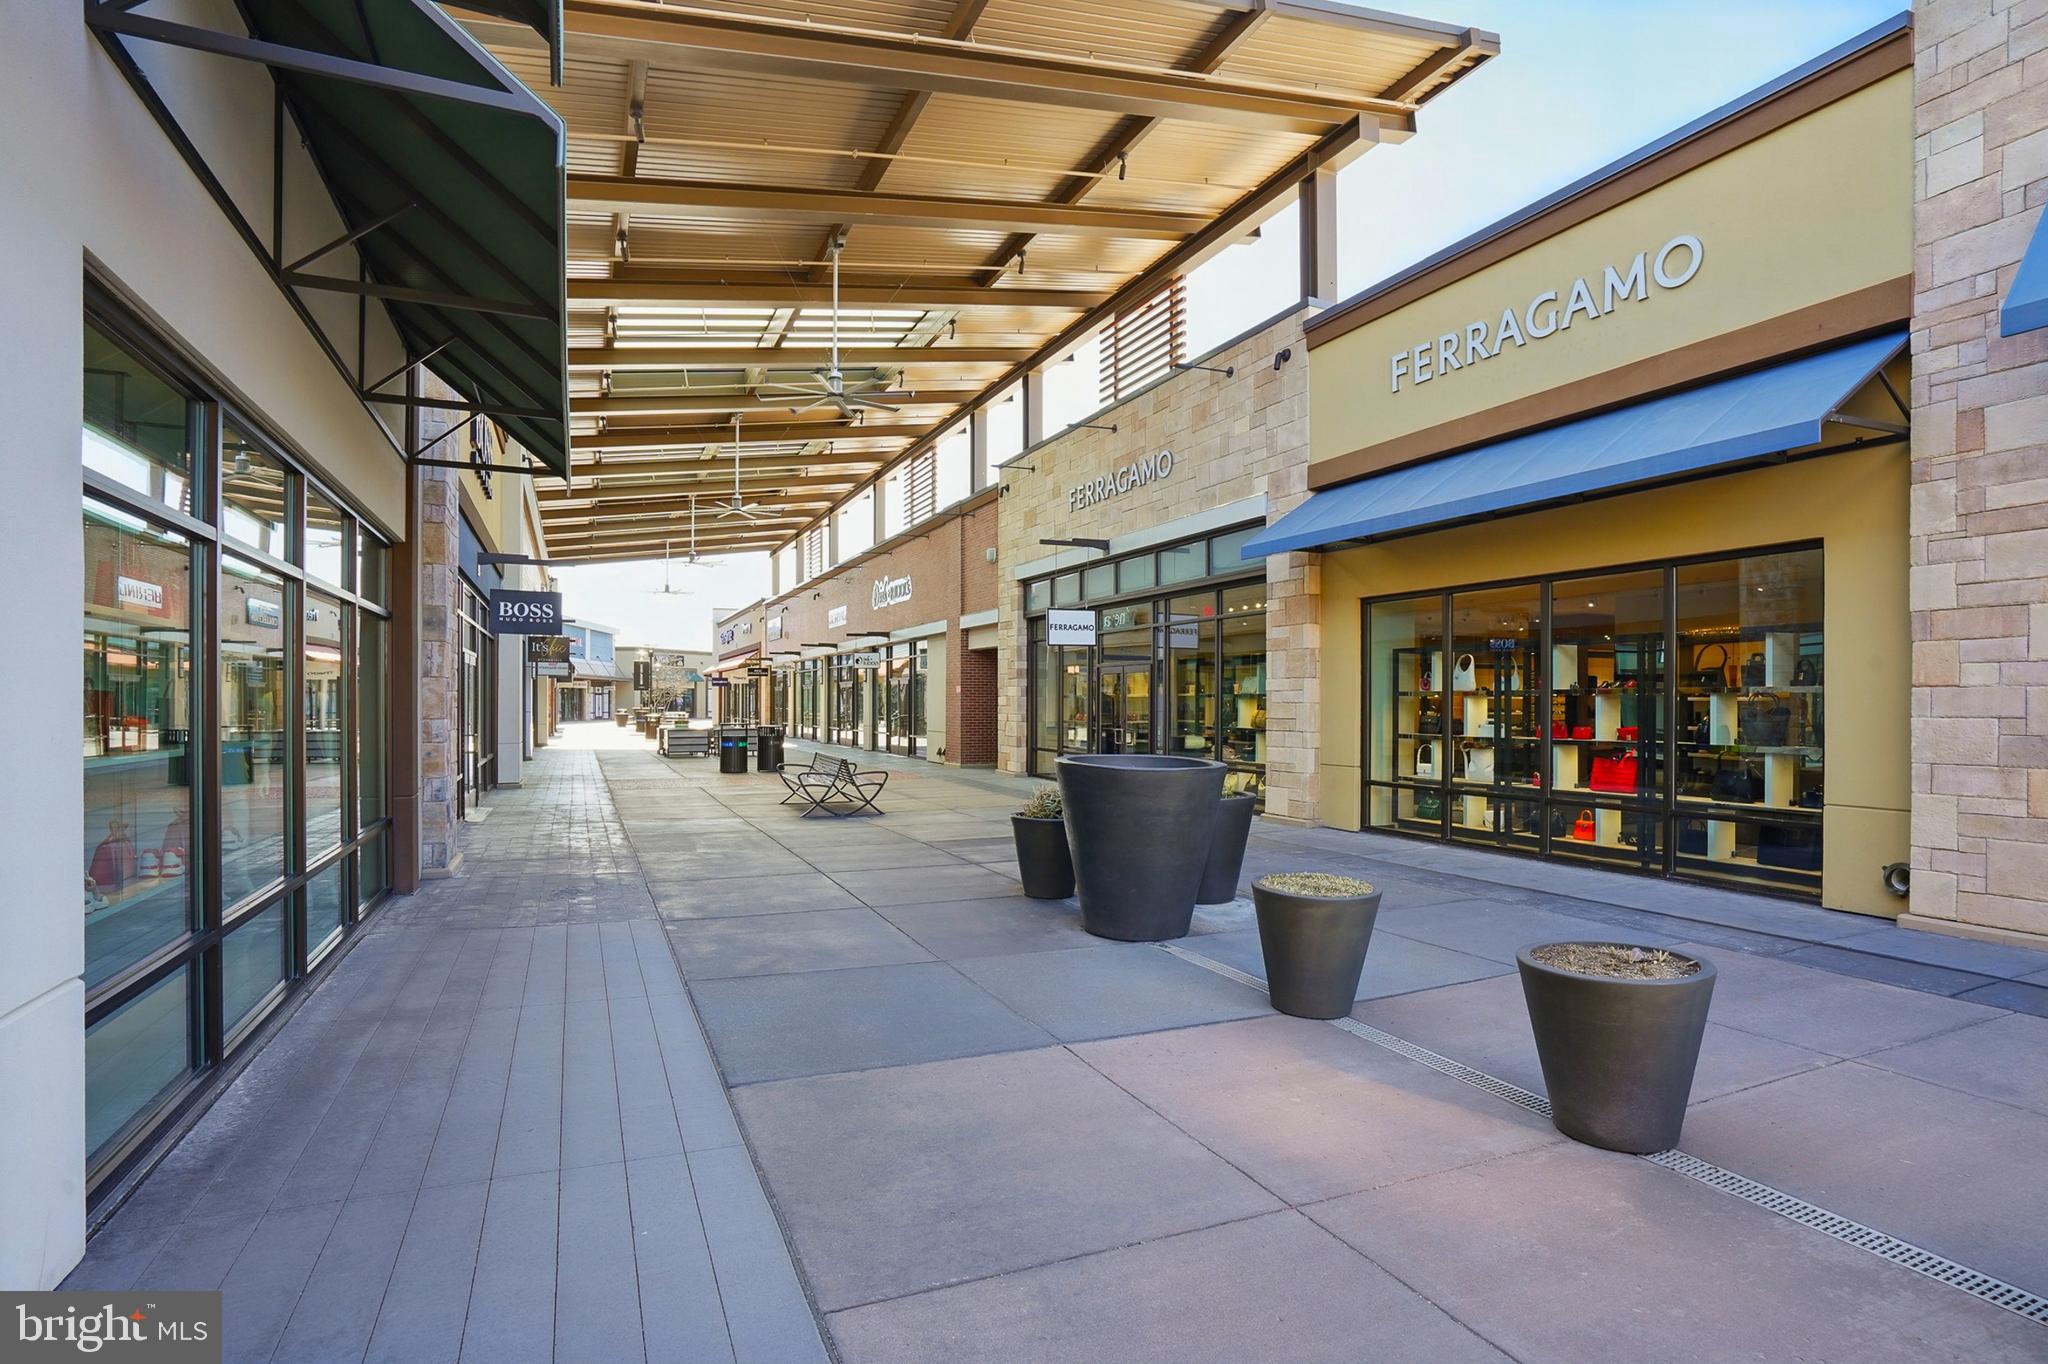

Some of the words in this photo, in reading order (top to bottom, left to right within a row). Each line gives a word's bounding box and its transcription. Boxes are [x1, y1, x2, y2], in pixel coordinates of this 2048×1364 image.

[1391, 234, 1704, 393] FERRAGAMO
[1068, 450, 1174, 512] FERRAGAMO
[499, 601, 554, 618] BOSS
[1049, 623, 1095, 632] FERRAGAMO
